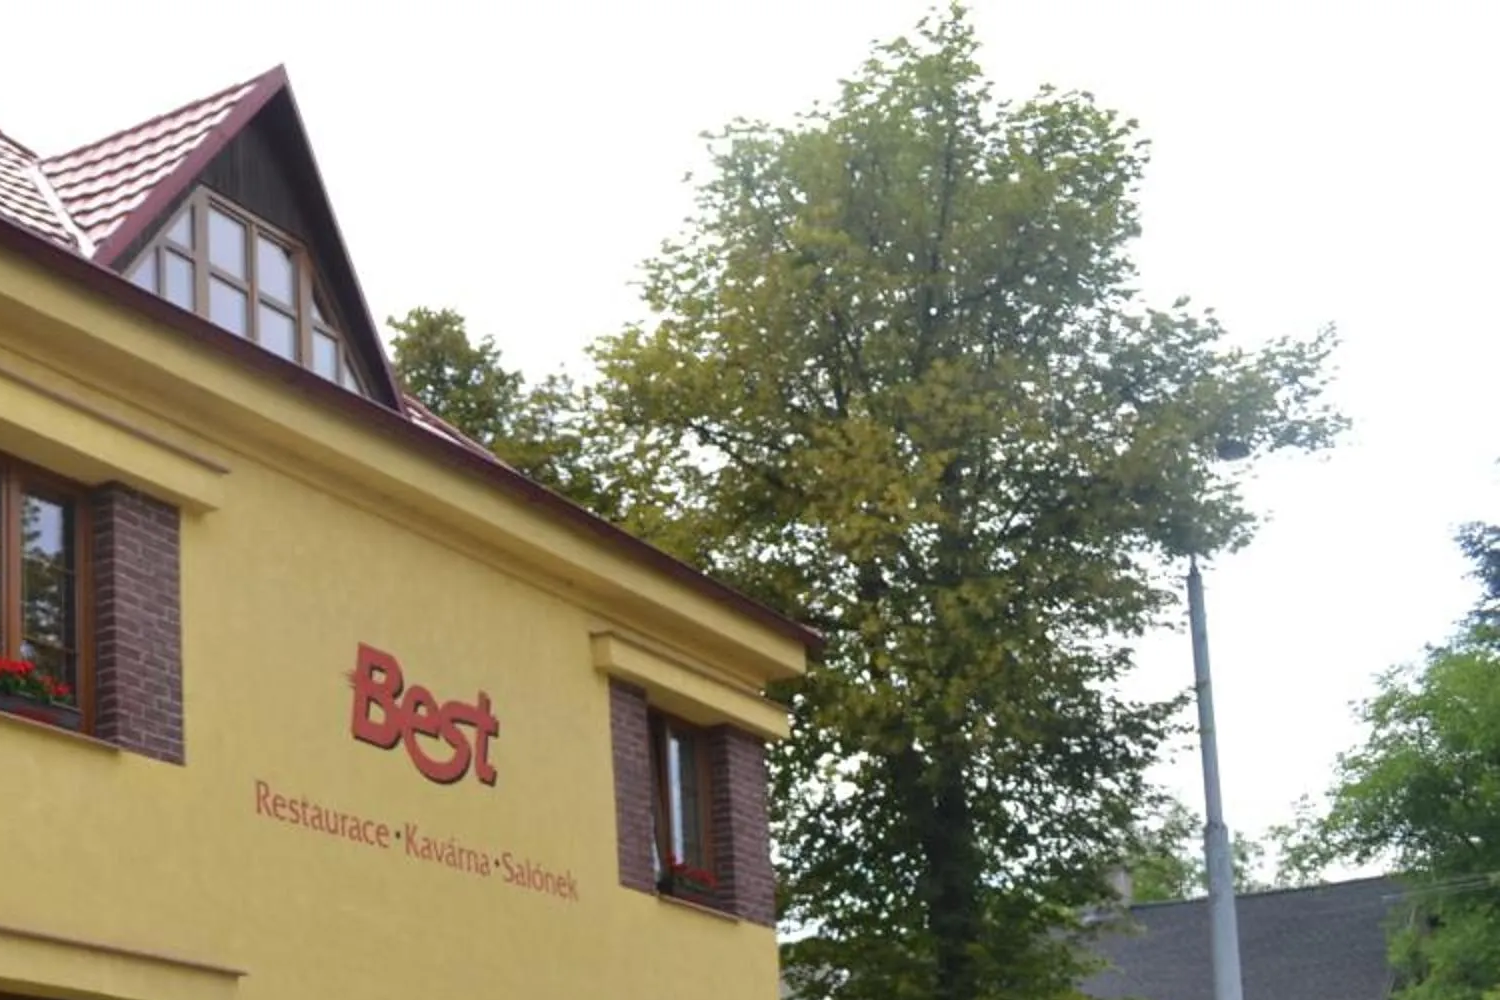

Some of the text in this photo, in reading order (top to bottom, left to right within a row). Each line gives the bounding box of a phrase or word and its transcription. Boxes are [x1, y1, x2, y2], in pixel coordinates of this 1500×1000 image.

[350, 642, 499, 787] Best
[255, 781, 580, 903] Restaurace Kavárna Salónek
